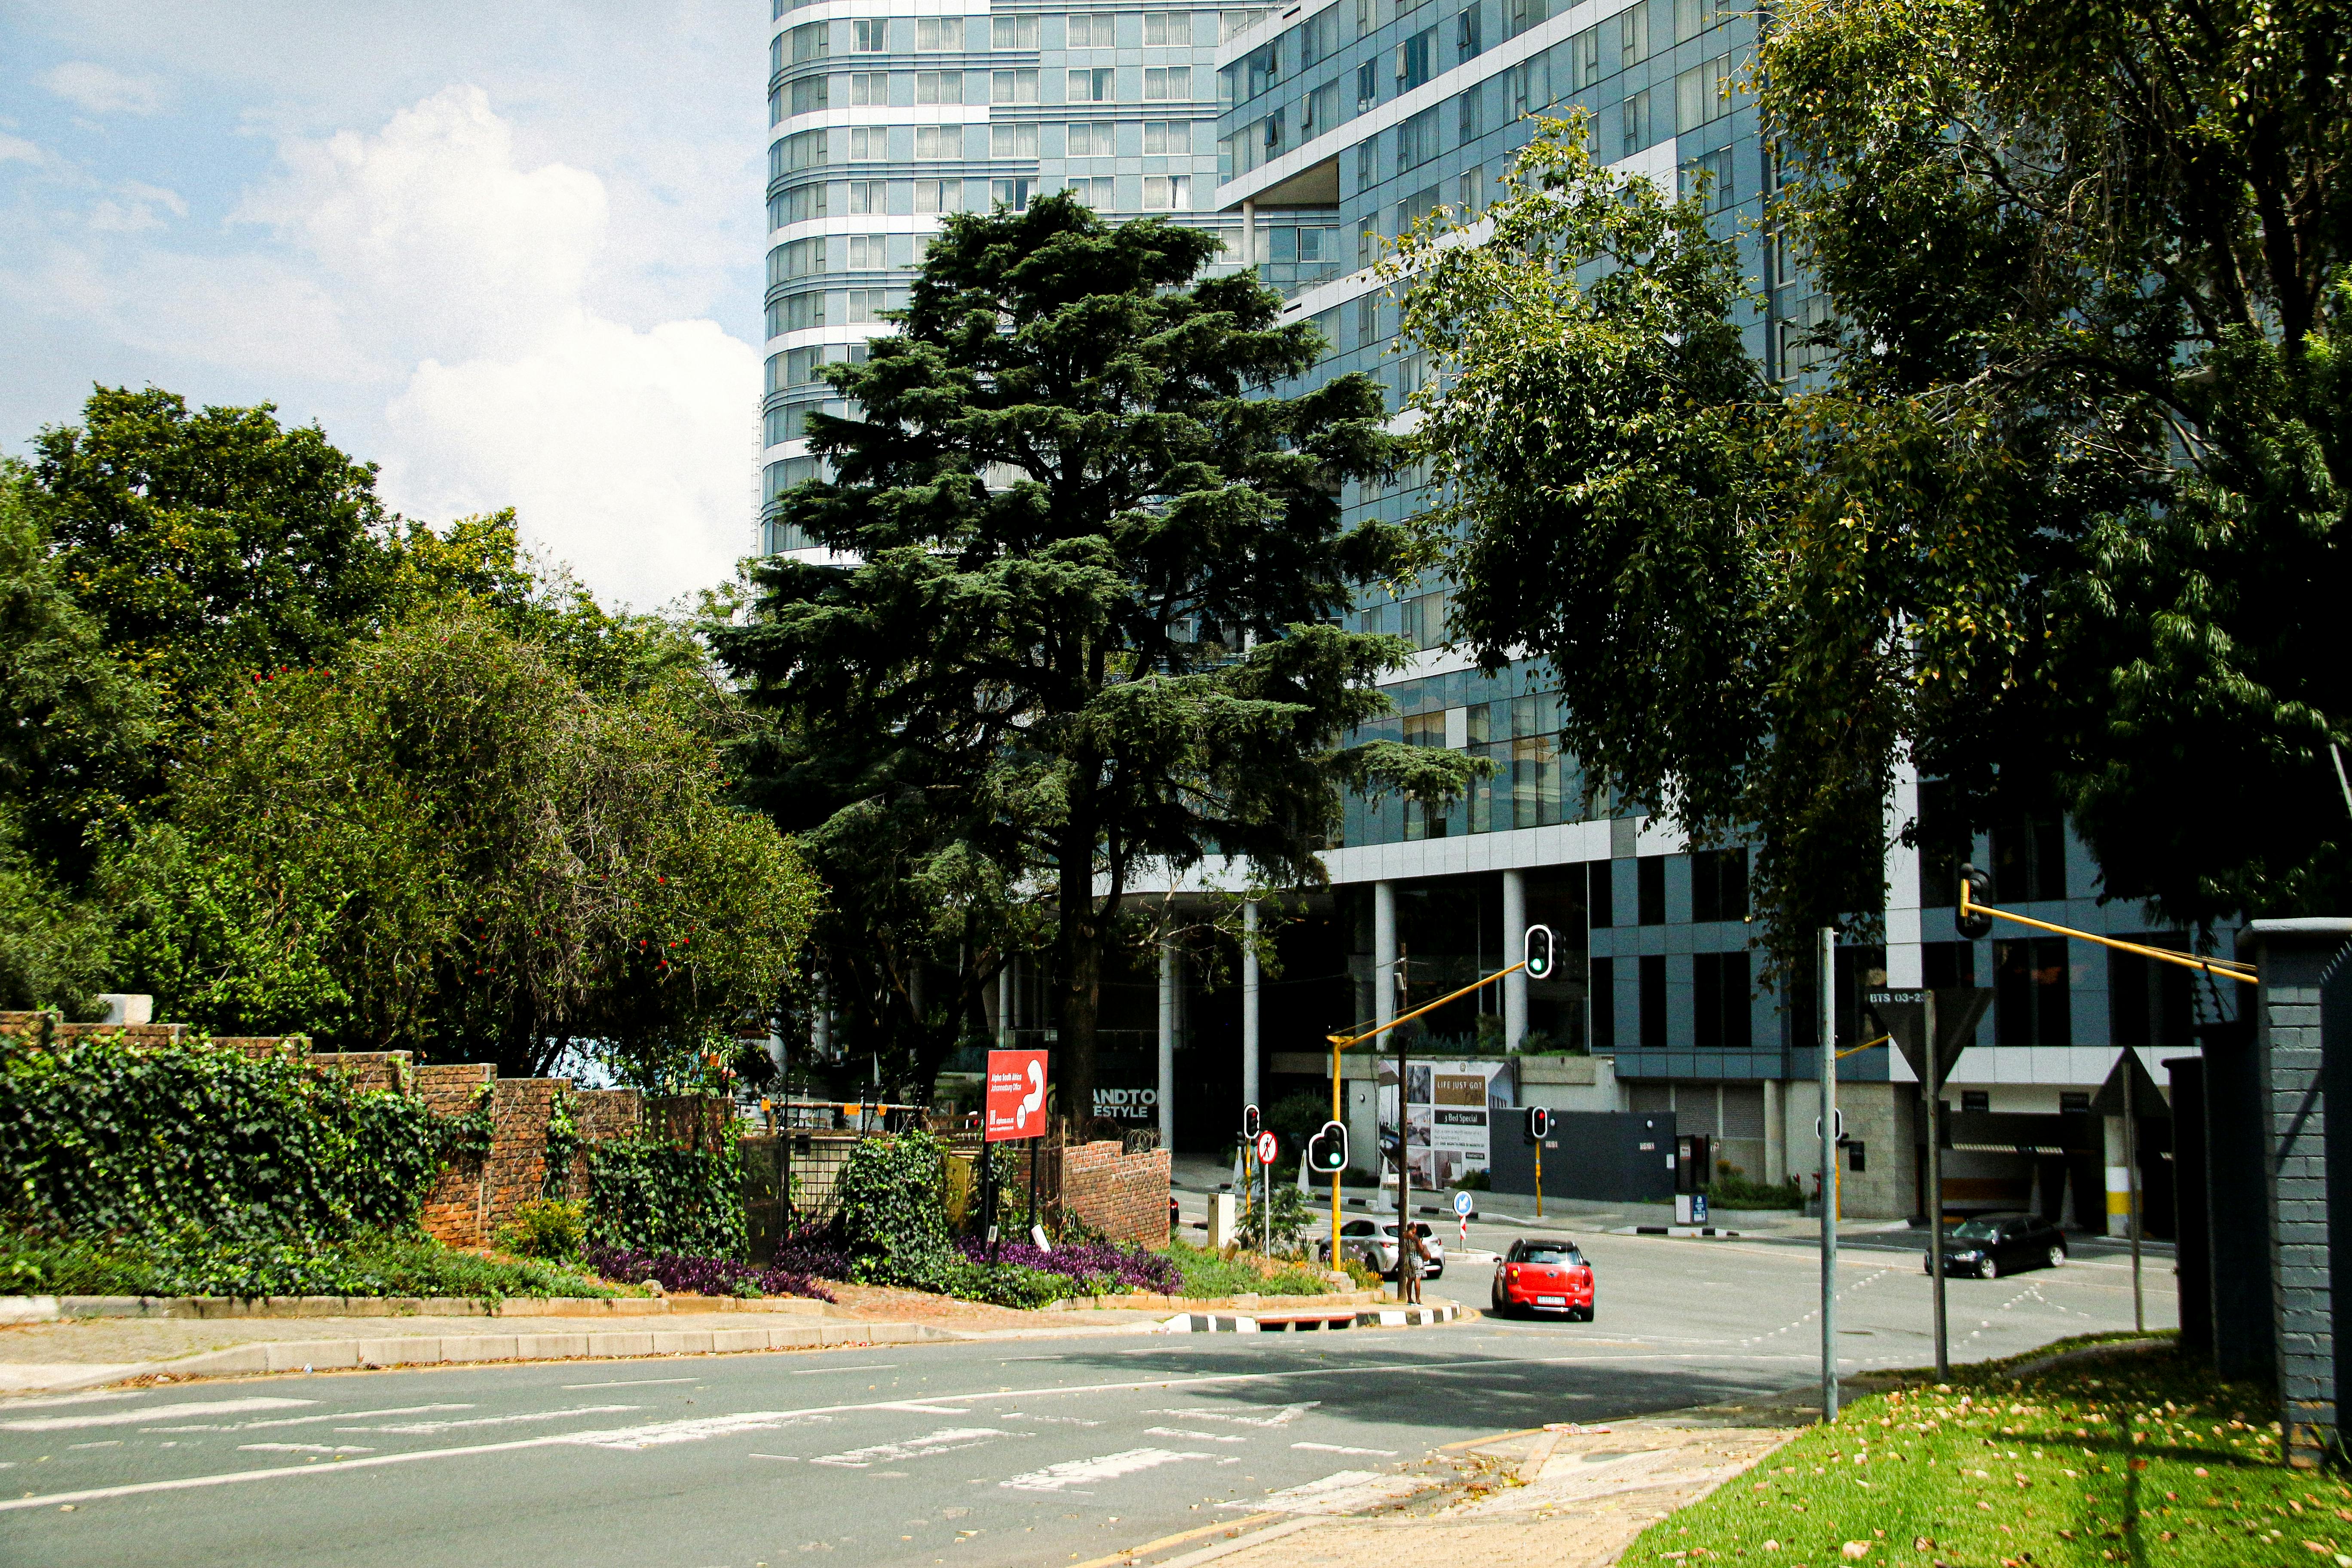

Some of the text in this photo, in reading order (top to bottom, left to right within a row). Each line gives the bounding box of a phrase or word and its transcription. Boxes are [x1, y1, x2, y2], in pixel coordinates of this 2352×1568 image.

[1870, 993, 1890, 1003] BTS
[1437, 1081, 1482, 1090] LIFE JUST GOT
[1093, 1088, 1159, 1104] ANDTO
[1449, 1113, 1458, 1121] Bed
[1459, 1114, 1477, 1124] Special
